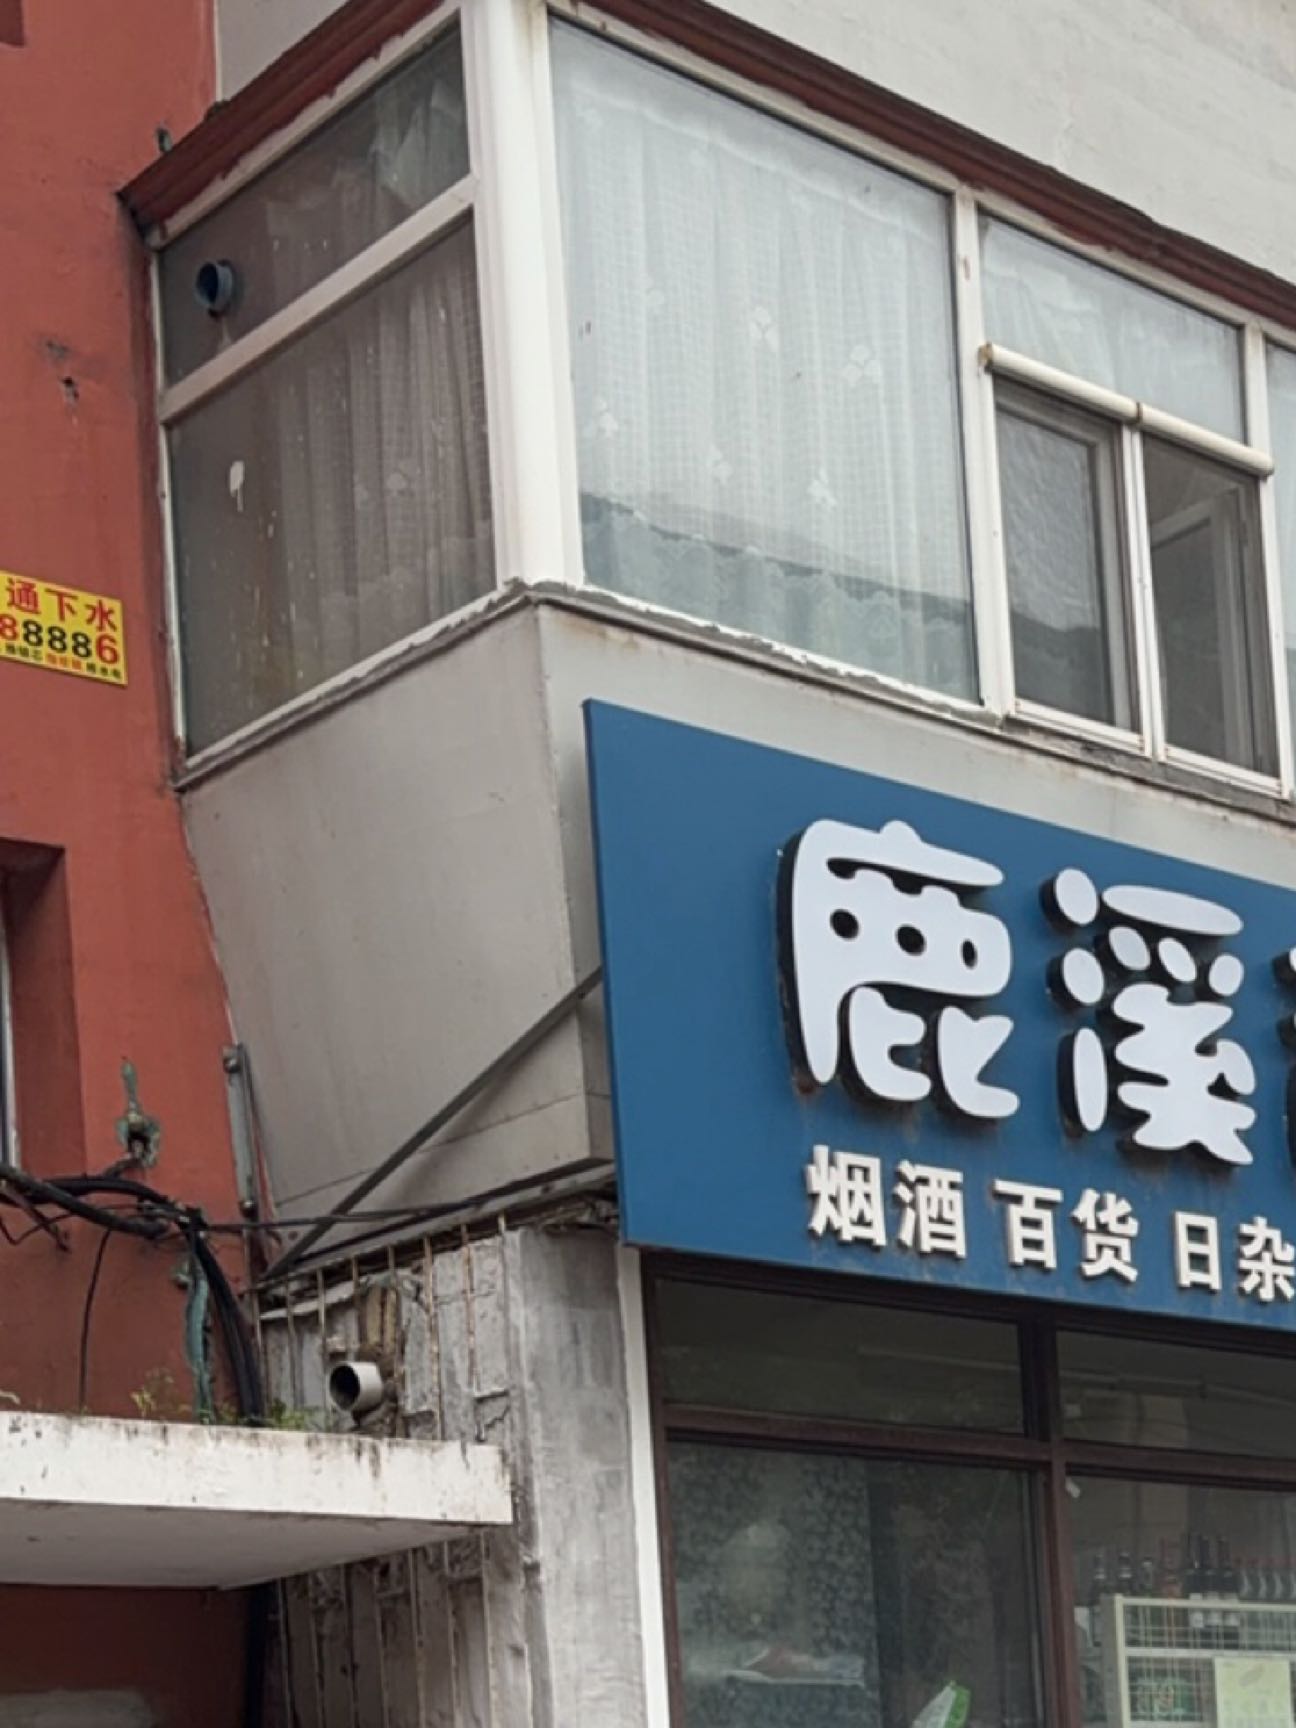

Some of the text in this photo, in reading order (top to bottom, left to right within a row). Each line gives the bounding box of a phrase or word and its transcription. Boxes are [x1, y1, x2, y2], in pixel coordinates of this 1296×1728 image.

[6, 577, 118, 632] 通下水
[806, 1143, 968, 1259] 烟酒
[992, 1178, 1140, 1286] 百货
[1173, 1211, 1296, 1303] 日杂
